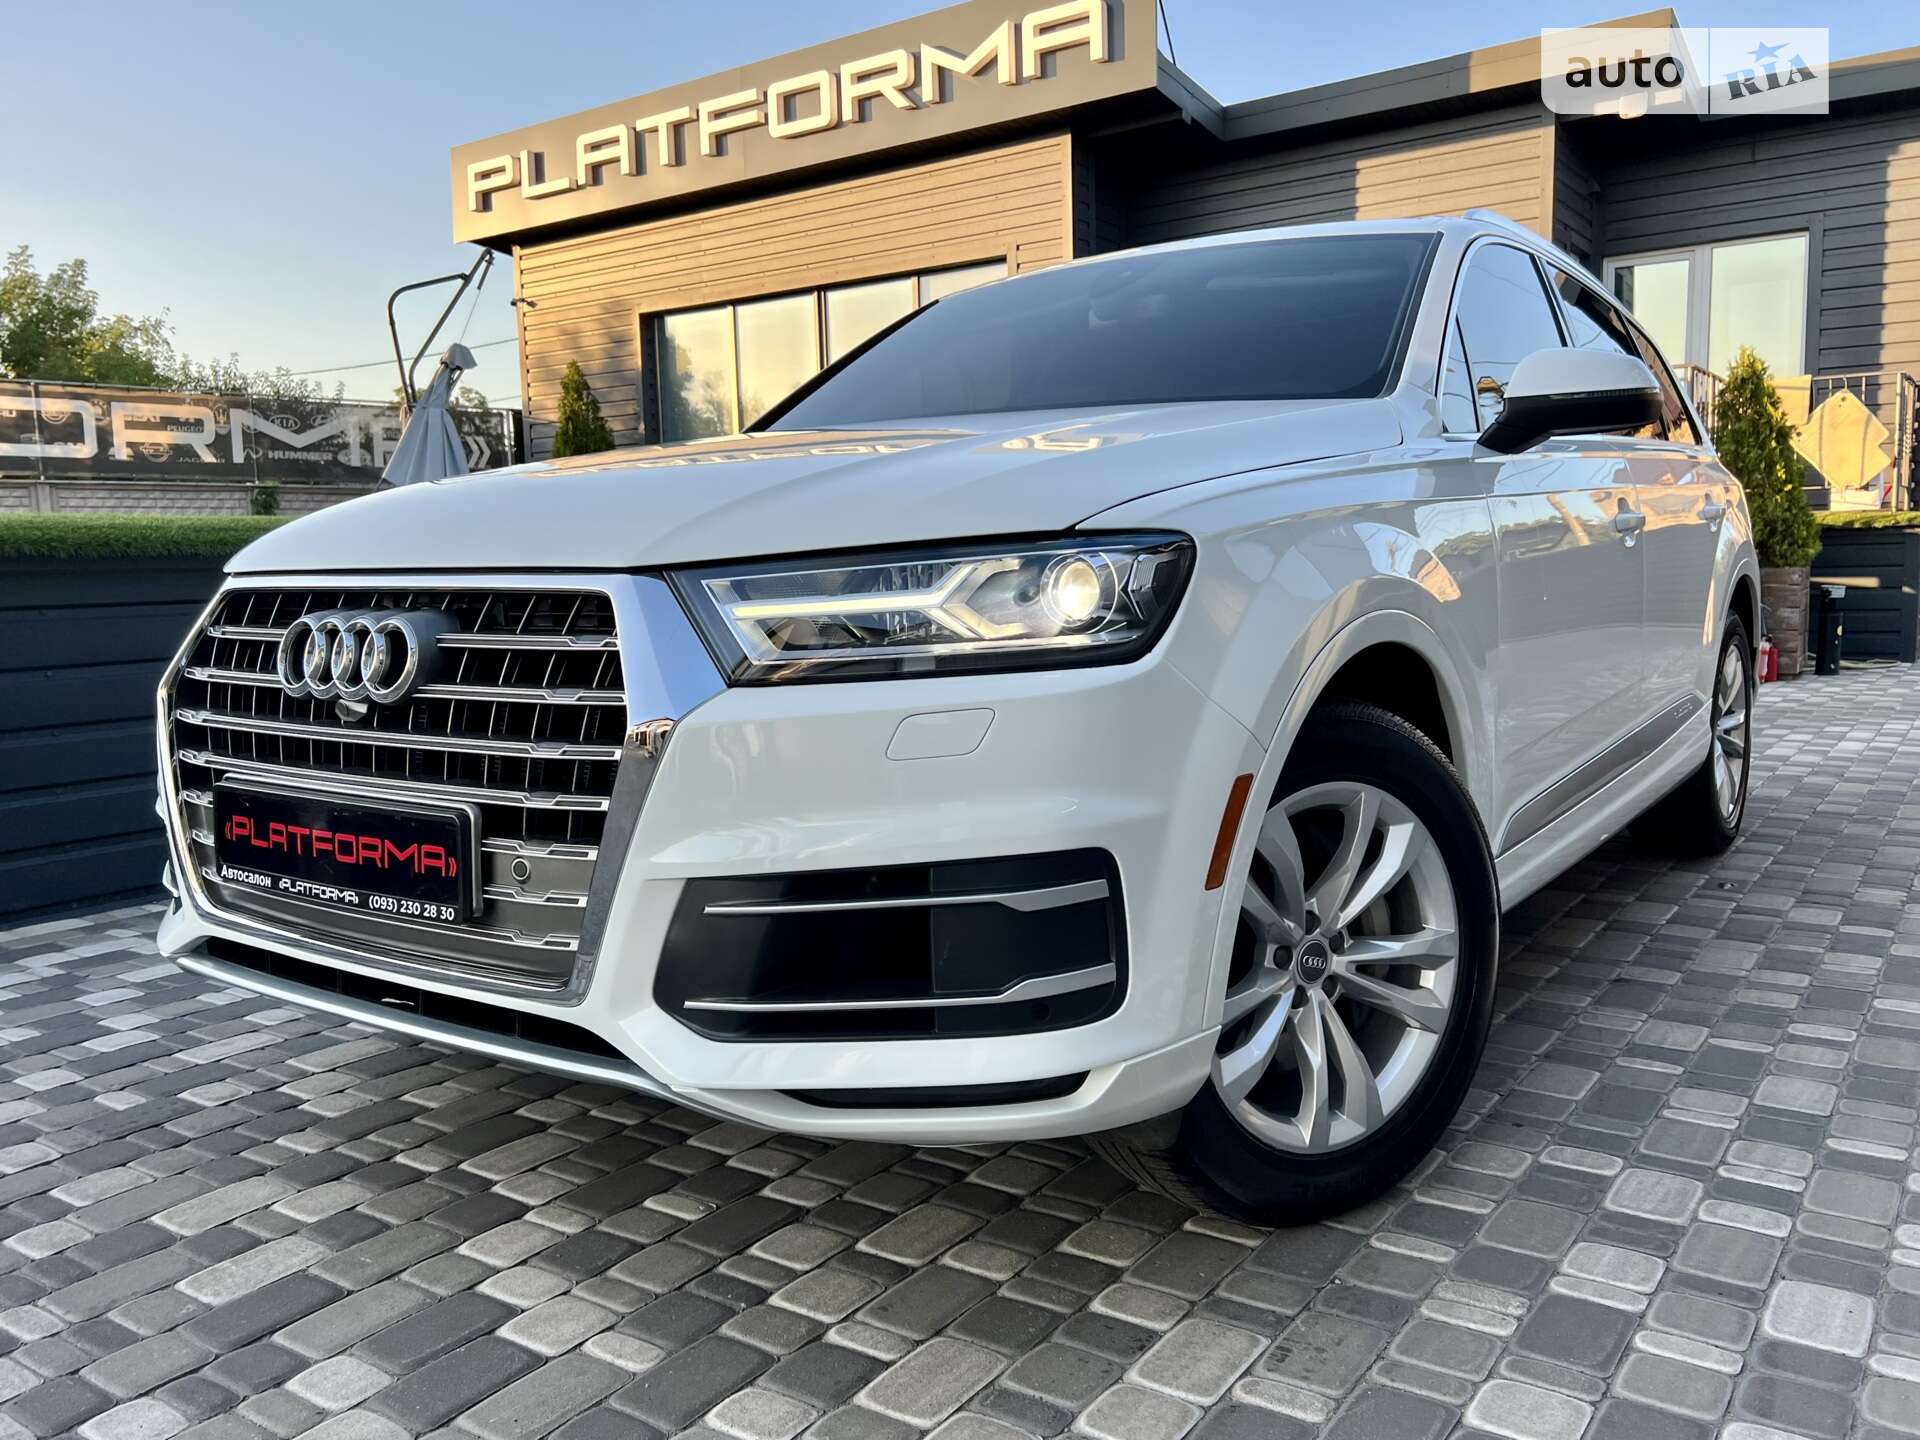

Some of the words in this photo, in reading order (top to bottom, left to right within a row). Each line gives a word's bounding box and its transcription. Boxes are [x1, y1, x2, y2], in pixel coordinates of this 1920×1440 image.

[467, 0, 1109, 212] PLATFORMA
[268, 450, 333, 461] HUMMER
[221, 864, 272, 888] Автосалон
[369, 895, 398, 912] (093)
[400, 900, 421, 915] 230
[423, 904, 437, 918] 28
[440, 906, 455, 921] 30
